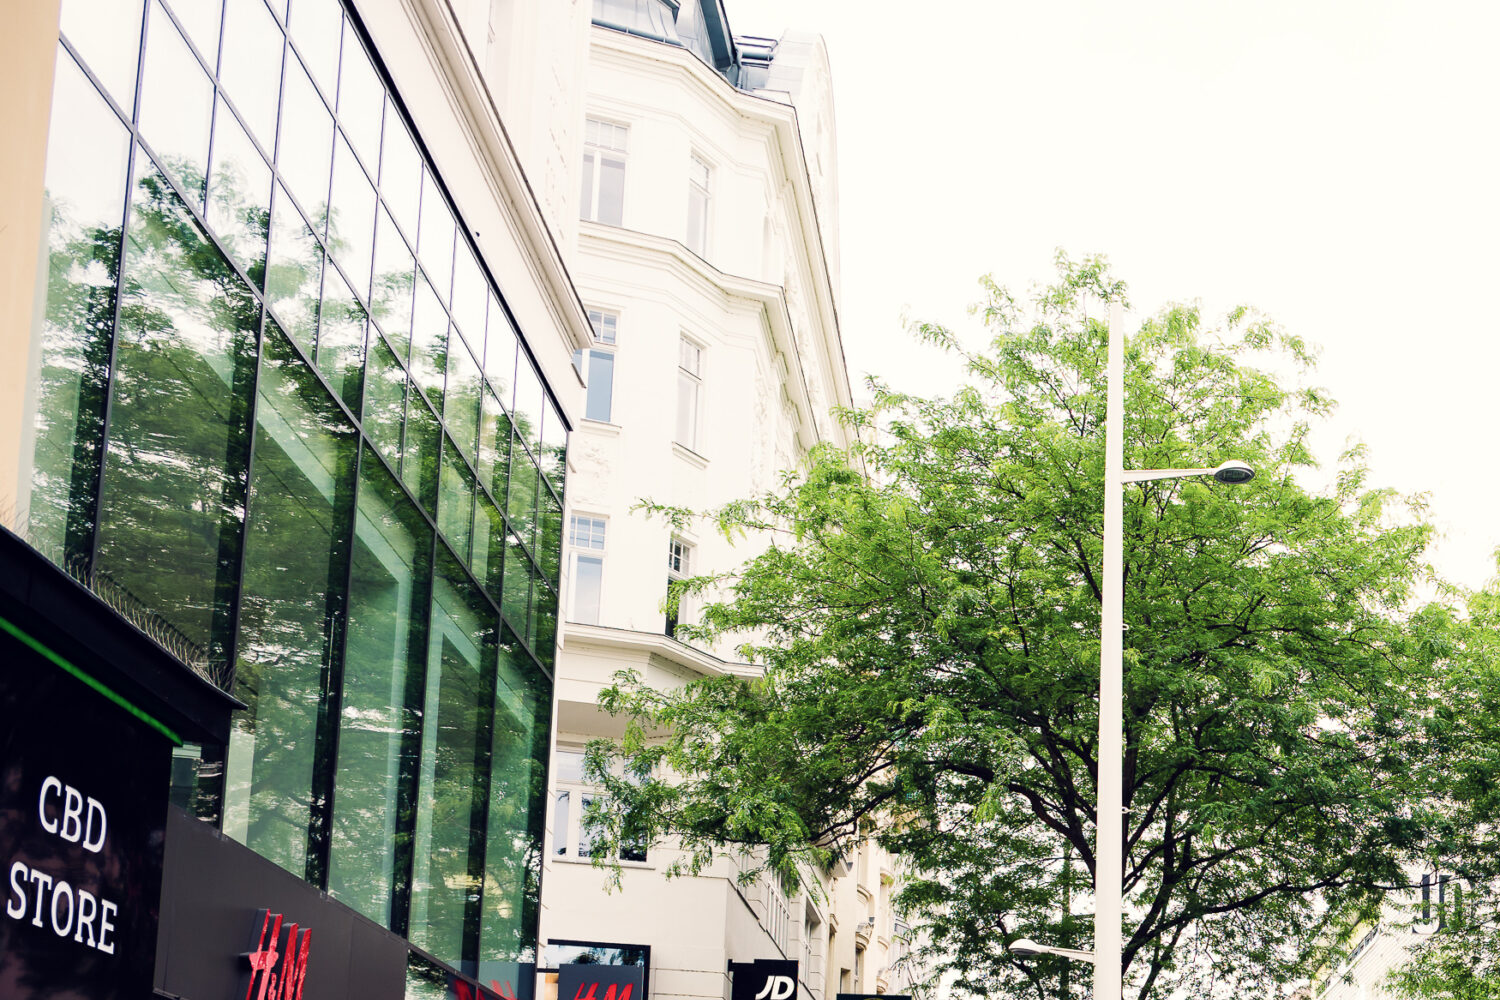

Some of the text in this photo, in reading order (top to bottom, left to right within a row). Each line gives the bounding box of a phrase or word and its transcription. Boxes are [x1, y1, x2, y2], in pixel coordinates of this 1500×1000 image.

[38, 775, 108, 854] CBD
[7, 861, 119, 955] STORE
[755, 975, 795, 1000] JD
